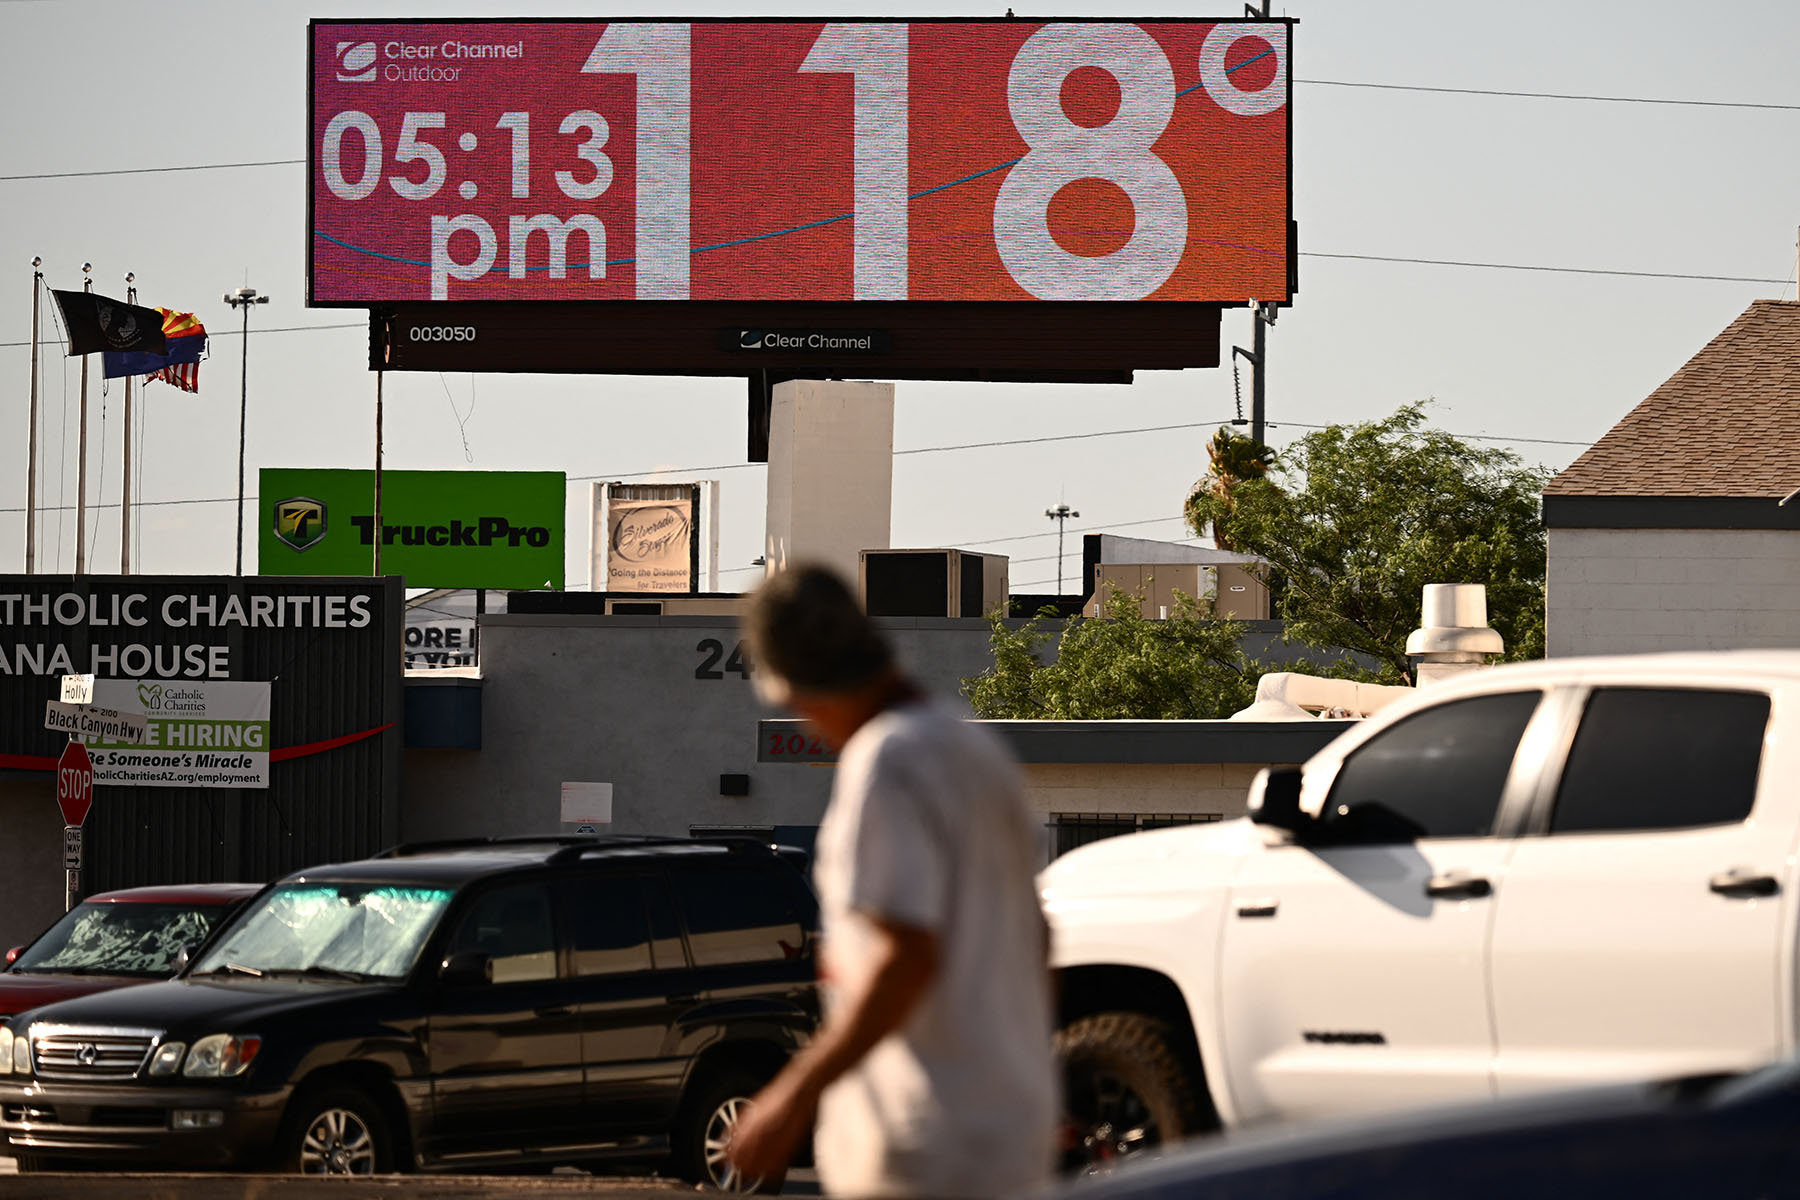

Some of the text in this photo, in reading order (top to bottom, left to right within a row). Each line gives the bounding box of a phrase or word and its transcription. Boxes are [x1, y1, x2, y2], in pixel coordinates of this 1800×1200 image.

[384, 40, 523, 58] Clear Channel
[384, 63, 461, 81] Outdoor
[322, 109, 614, 200] 05:13
[431, 213, 606, 300] pm
[410, 326, 475, 342] 003050
[764, 333, 871, 350] Clear Channel
[351, 515, 550, 548] TruckPro
[620, 511, 674, 546] Silverado
[610, 567, 687, 579] Going the Distance
[637, 580, 688, 589] for Travelers
[0, 592, 372, 629] THOLIC CHARITIES
[91, 643, 230, 679] HOUSE
[64, 684, 88, 703] Holly
[164, 688, 205, 700] Catholic
[100, 708, 118, 718] 2100
[164, 700, 206, 711] Charities
[48, 709, 79, 729] Black
[80, 714, 119, 737] Canyon
[120, 721, 143, 744] Hwy
[167, 723, 263, 748] HIRING
[107, 752, 192, 768] Someone's
[195, 754, 253, 769] Miracle
[60, 767, 91, 800] STOP
[67, 831, 81, 842] ONE
[67, 843, 81, 854] WAY
